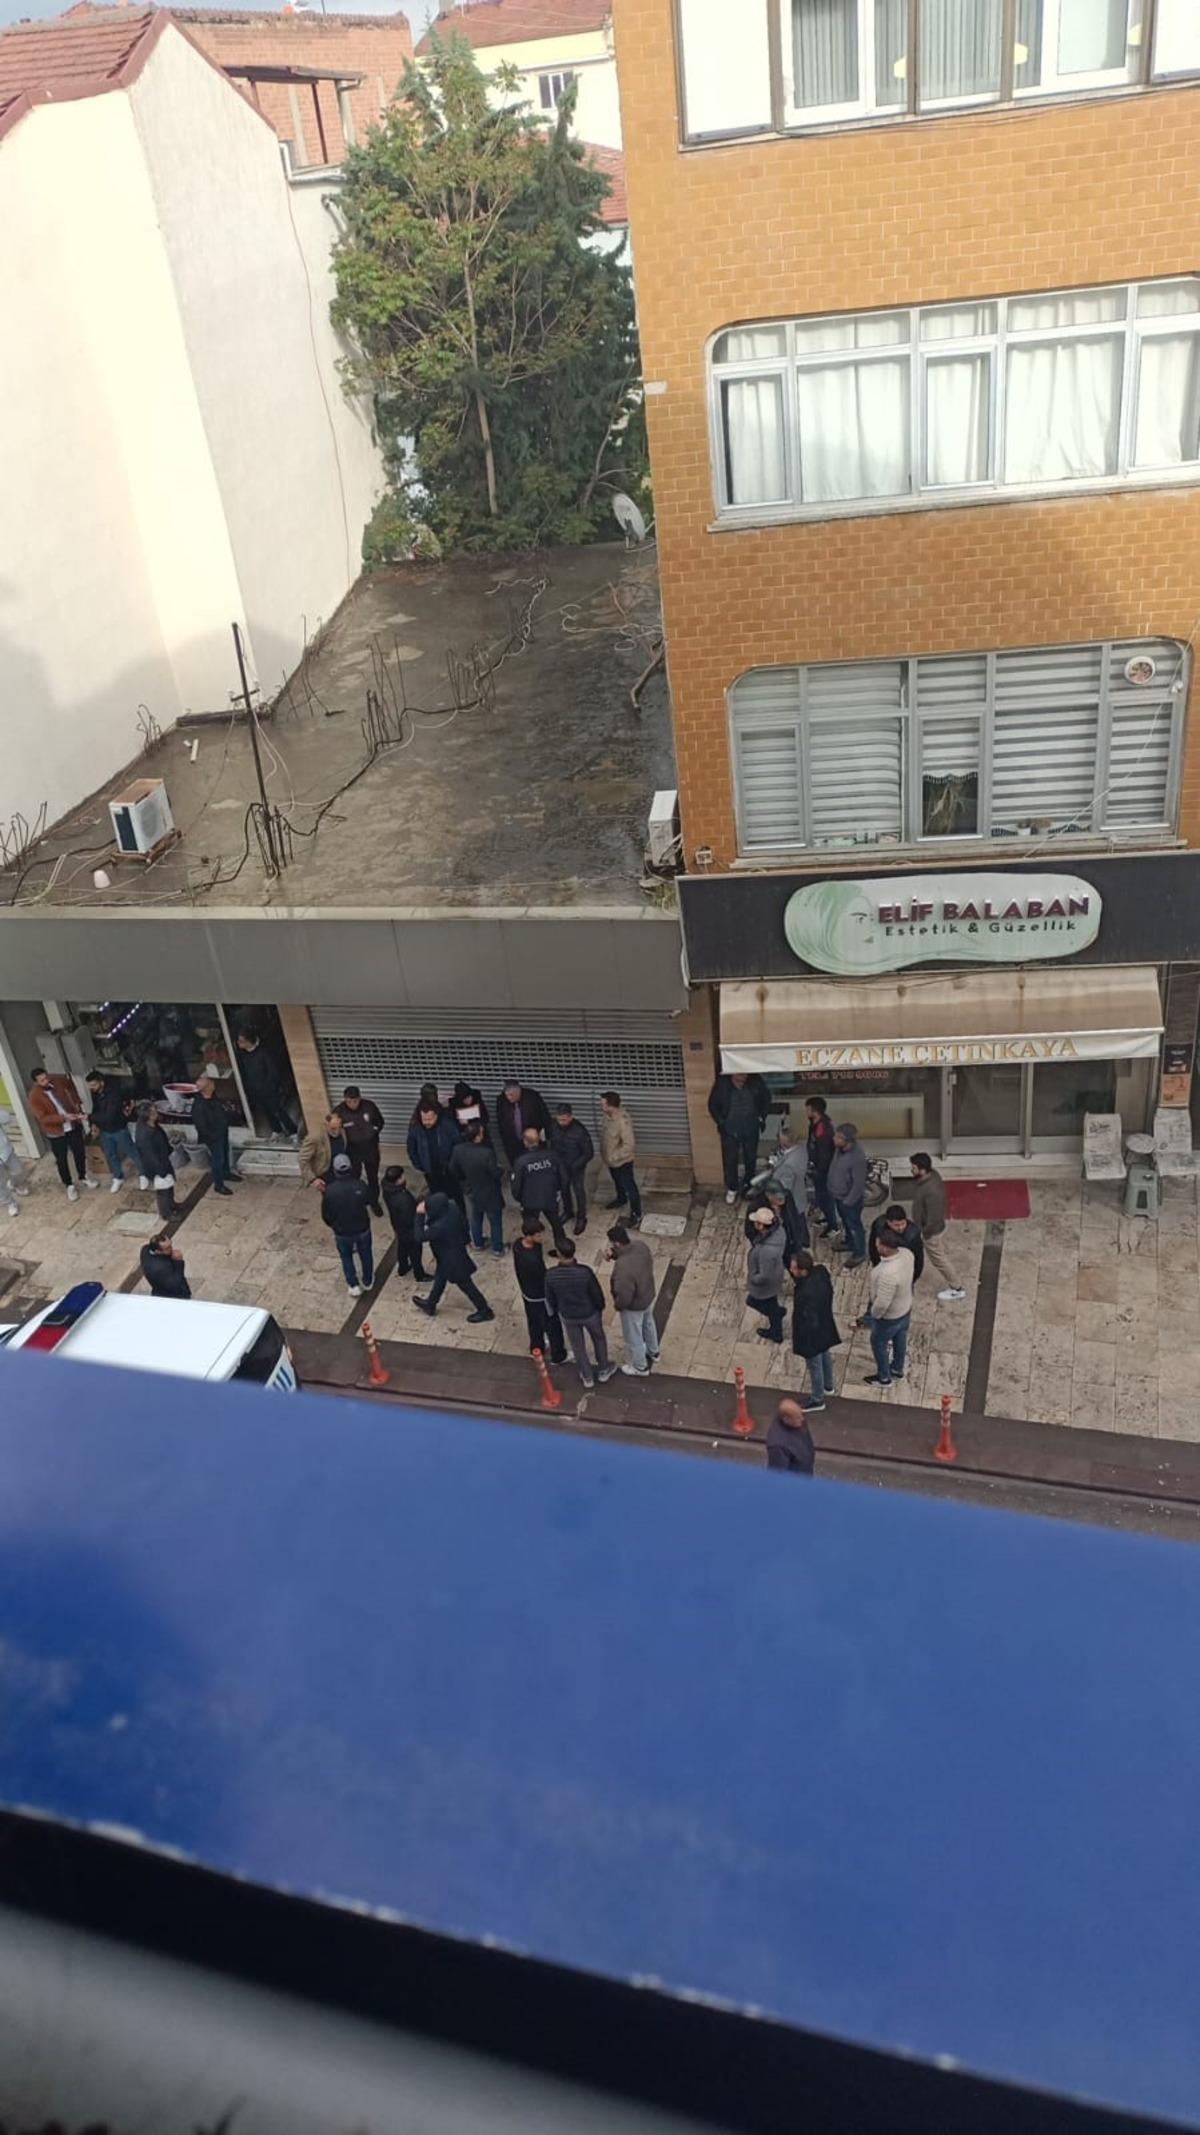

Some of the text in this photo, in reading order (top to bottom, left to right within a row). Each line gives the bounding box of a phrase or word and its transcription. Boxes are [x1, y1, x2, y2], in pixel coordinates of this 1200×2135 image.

[879, 895, 1089, 923] ELİF BALABAN
[885, 920, 1077, 937] Estetik & Güzellik
[795, 1045, 906, 1067] ECZANE
